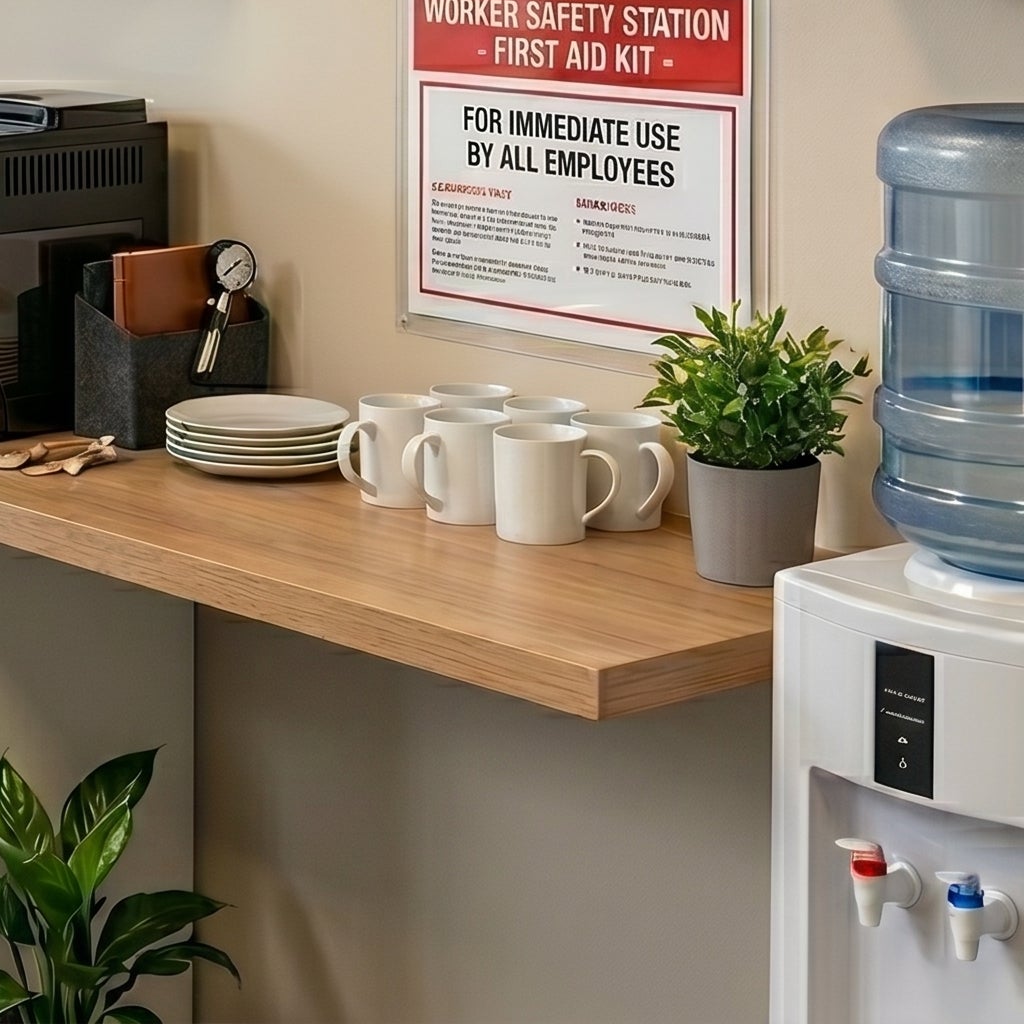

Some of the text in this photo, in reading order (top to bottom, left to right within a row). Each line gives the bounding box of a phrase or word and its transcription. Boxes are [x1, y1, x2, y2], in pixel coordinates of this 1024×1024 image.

[526, 0, 615, 34] SAFETY
[622, 5, 730, 41] STATION
[494, 36, 559, 69] FIRST
[565, 40, 607, 72] AID
[615, 43, 655, 75] KIT
[463, 106, 681, 151] FOR IMMEDIATE USE
[467, 141, 675, 188] BY ALL EMPLOYEES
